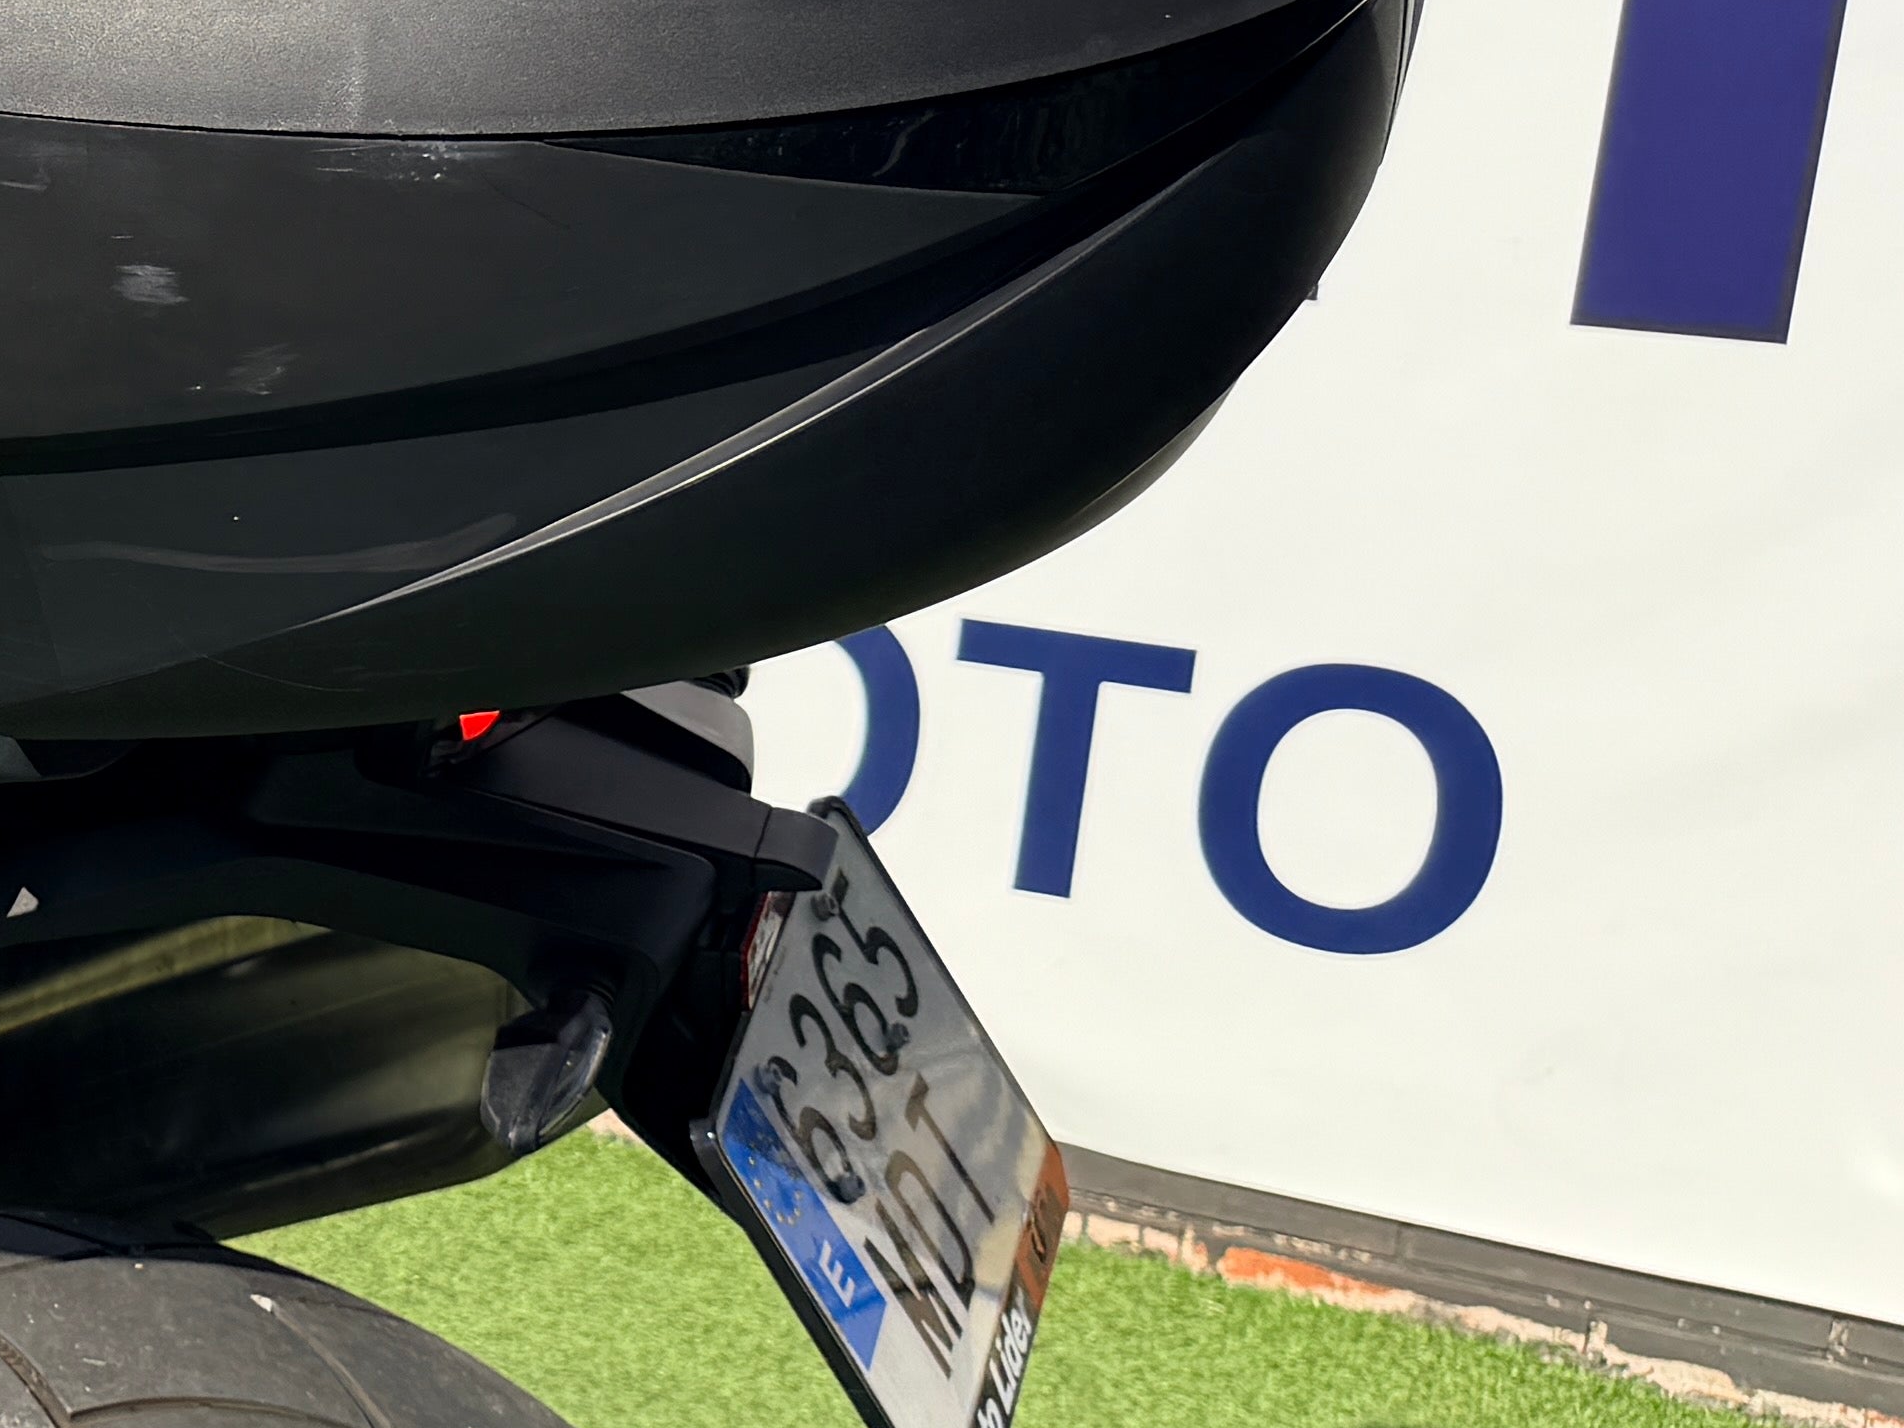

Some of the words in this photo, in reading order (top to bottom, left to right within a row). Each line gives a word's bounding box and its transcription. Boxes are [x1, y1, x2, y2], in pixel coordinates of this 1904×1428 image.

[757, 868, 919, 1204] 6365
[819, 1239, 856, 1309] E
[863, 1072, 996, 1380] MDT
